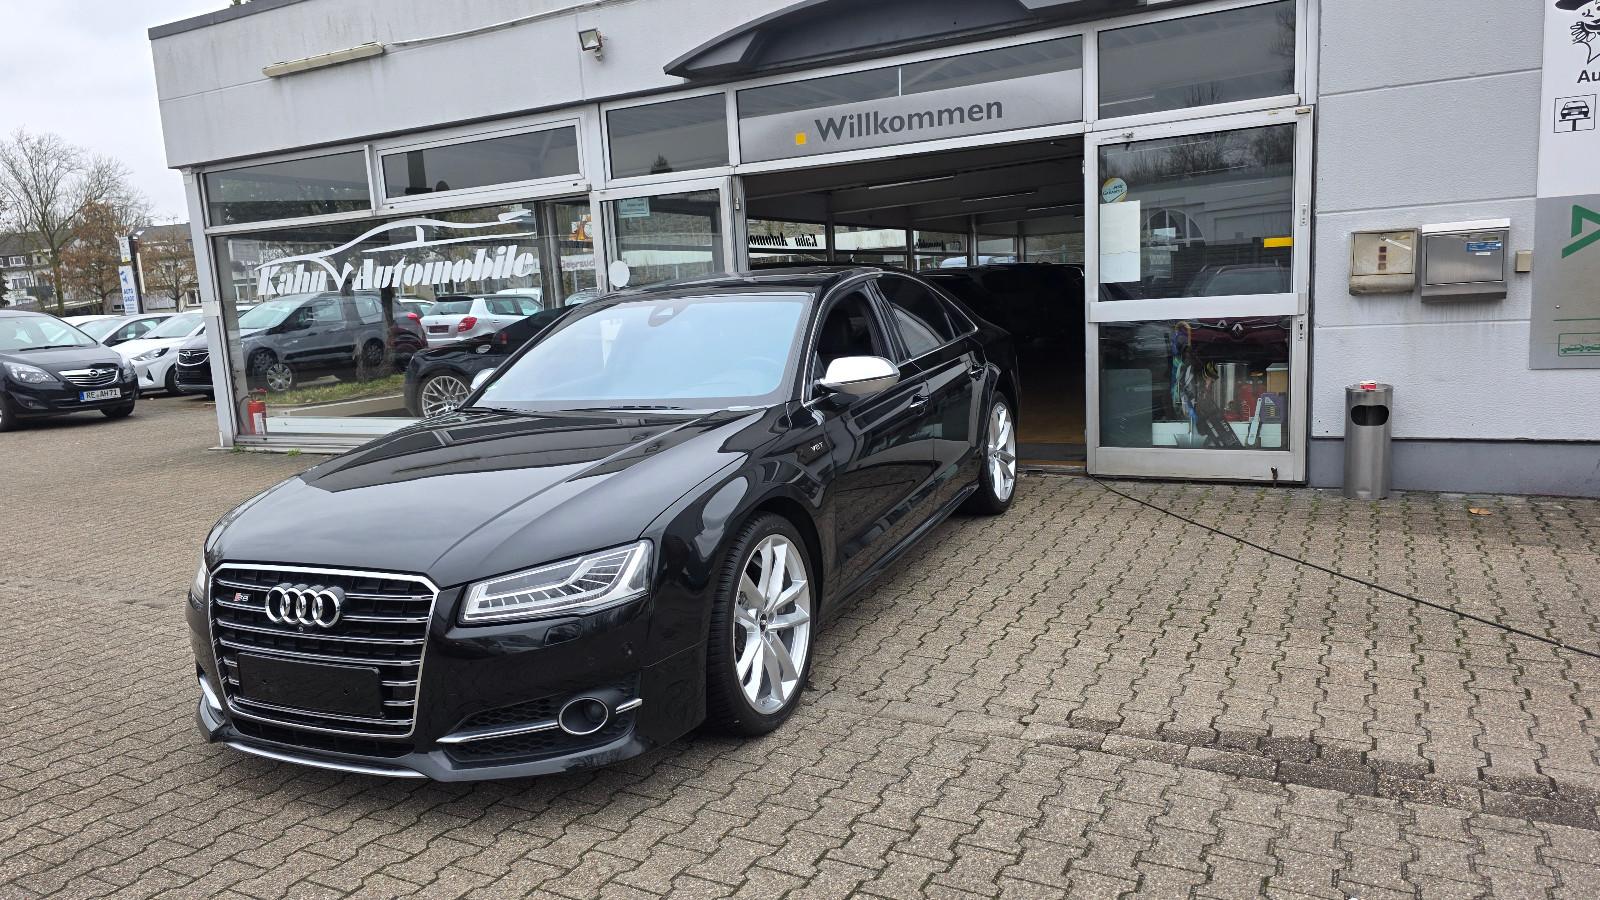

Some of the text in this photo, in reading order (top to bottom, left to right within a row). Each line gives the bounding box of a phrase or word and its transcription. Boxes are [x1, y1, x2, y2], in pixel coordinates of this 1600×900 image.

[1576, 69, 1600, 83] Au
[814, 102, 1003, 142] Willkommen
[257, 244, 535, 296] Kahn Automobile
[86, 391, 96, 399] RE
